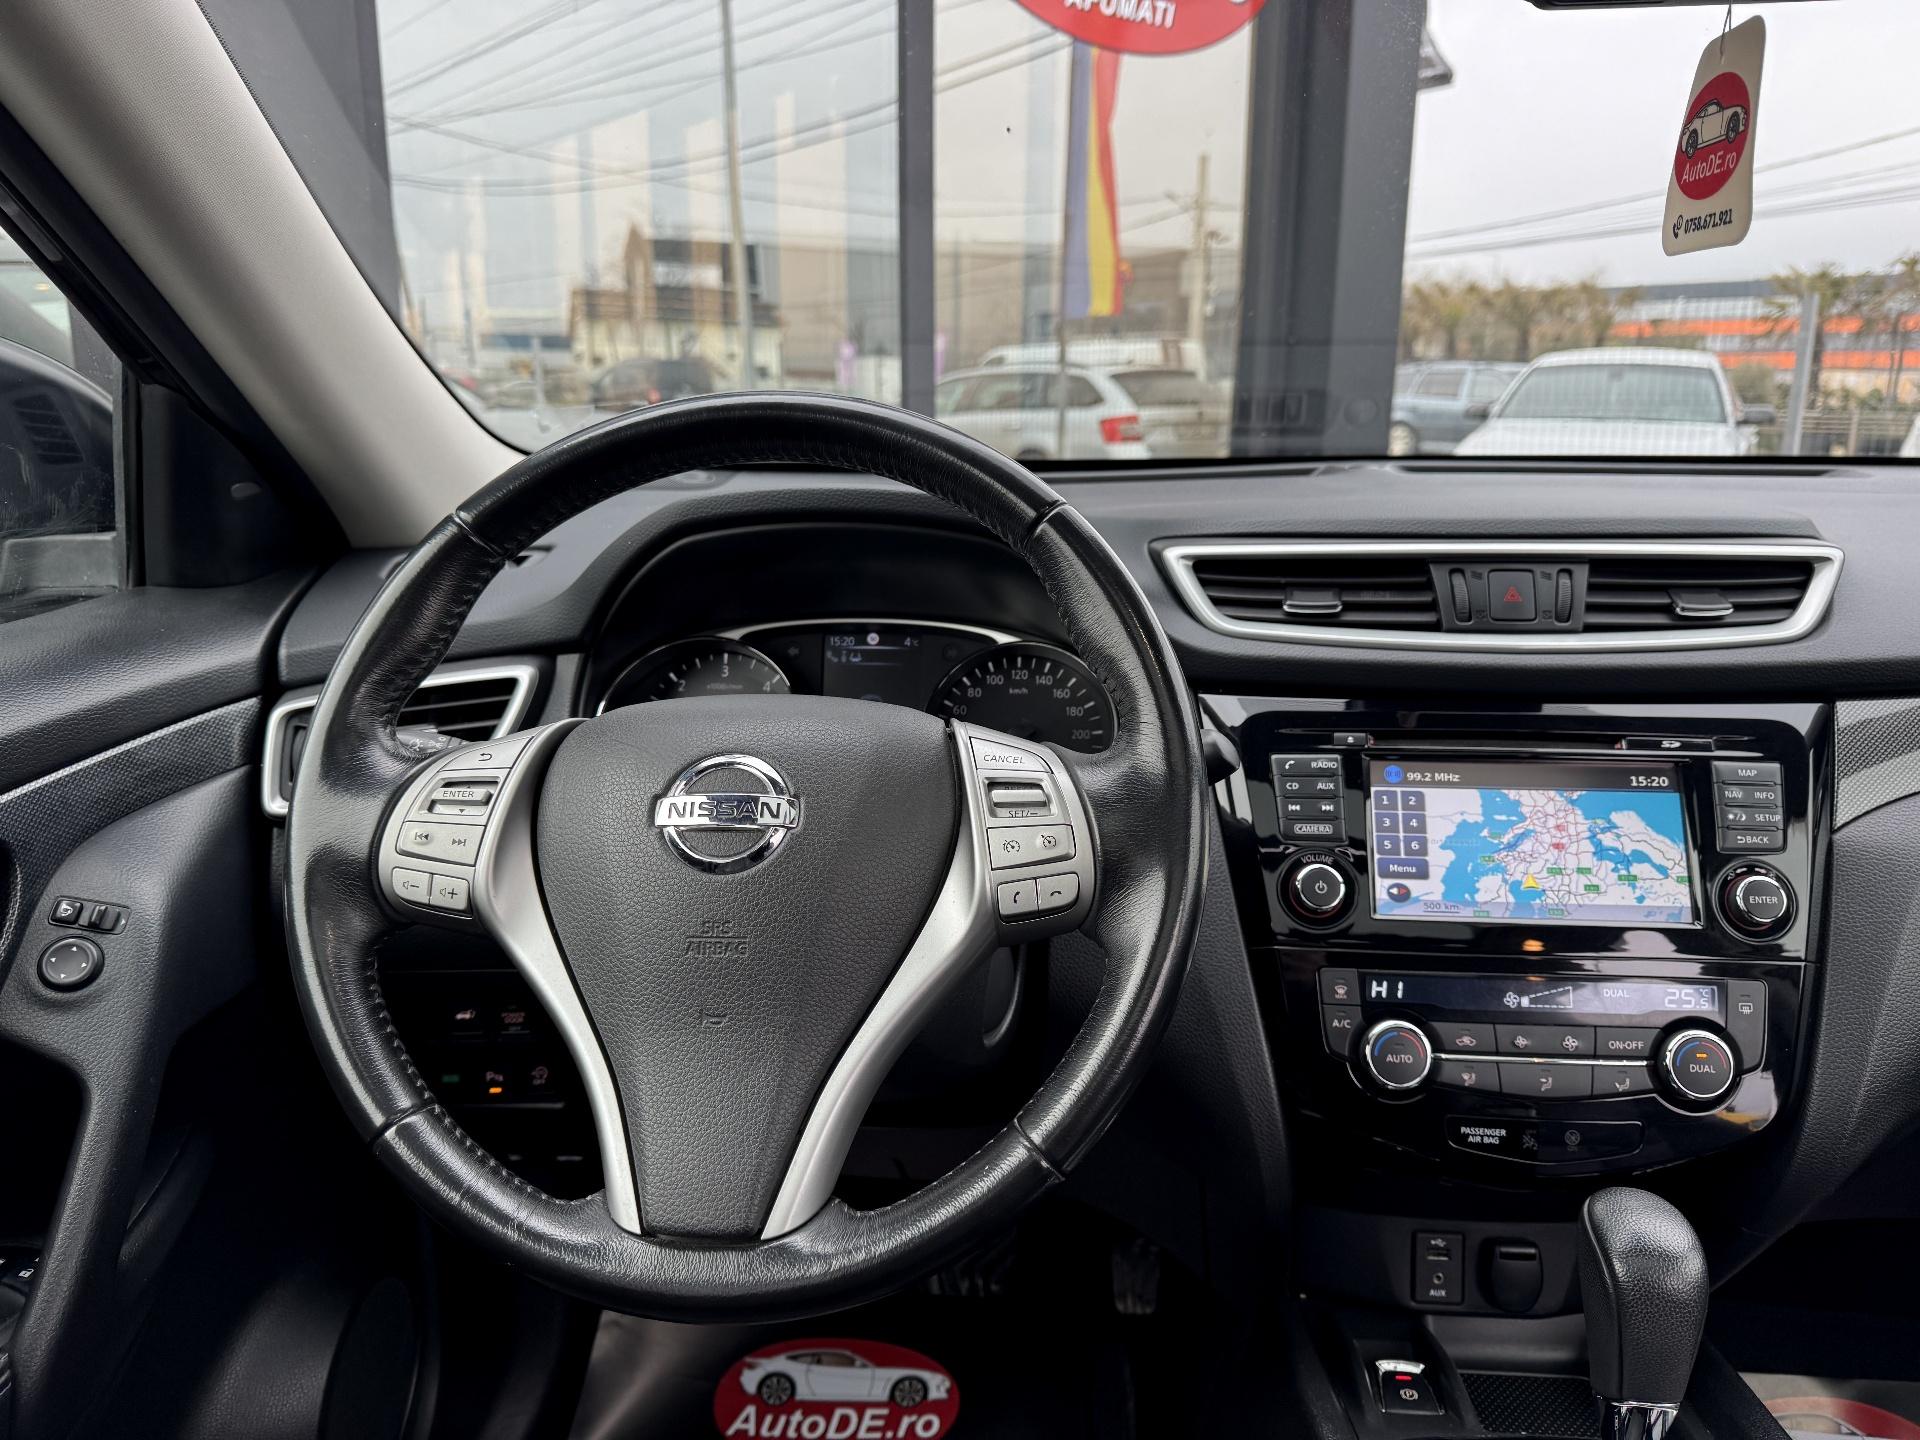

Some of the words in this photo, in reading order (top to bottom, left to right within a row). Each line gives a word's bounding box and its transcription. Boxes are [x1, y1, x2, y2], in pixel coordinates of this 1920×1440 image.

[1681, 151, 1737, 184] AutoDE.ro
[1684, 208, 1732, 234] 0758.671.921
[721, 665, 730, 678] 3
[1011, 669, 1029, 681] 120
[986, 674, 1004, 686] 100
[1035, 674, 1053, 686] 140
[677, 679, 687, 692] 2
[762, 680, 771, 692] 4
[967, 687, 982, 698] 80
[1053, 687, 1071, 699] 160
[953, 705, 967, 716] 60
[1066, 706, 1084, 717] 180
[1071, 728, 1091, 740] 200
[983, 754, 1025, 765] CANCEL
[1311, 761, 1337, 769] RADIO
[1406, 772, 1432, 782] 99.2
[1435, 772, 1461, 783] MHz
[1738, 768, 1758, 777] MAP
[1286, 782, 1299, 790] CD
[1317, 782, 1335, 790] AUX
[1629, 775, 1670, 787] 15:20
[442, 790, 474, 799] ENTER
[1725, 790, 1742, 799] NAV
[1754, 791, 1775, 800] INFO
[1382, 795, 1389, 805] 1
[1409, 796, 1416, 805] 2
[667, 801, 781, 820] NISSAN
[1382, 817, 1391, 827] 3
[1755, 813, 1781, 822] SETUP
[1409, 818, 1418, 828] 4
[1296, 824, 1331, 834] CAMERA
[1384, 839, 1391, 849] 5
[1746, 835, 1769, 844] BACK
[1411, 840, 1419, 850] 6
[1301, 855, 1334, 864] VOLUME
[1389, 864, 1416, 873] Menu
[1749, 895, 1778, 904] ENTER
[1423, 902, 1441, 911] 500
[1444, 903, 1460, 911] km
[703, 922, 732, 937] SRS
[687, 940, 747, 956] AIRBAG
[1604, 989, 1629, 998] DUAL
[1332, 1019, 1351, 1028] A/C
[1386, 1054, 1413, 1063] AUTO
[1690, 1064, 1715, 1073] DUAL
[1460, 1127, 1507, 1136] PASSENGER
[1468, 1135, 1481, 1143] AIR
[1483, 1136, 1500, 1144] BAG
[1429, 1288, 1447, 1297] AUX
[726, 1404, 941, 1440] AutoDE.ro
